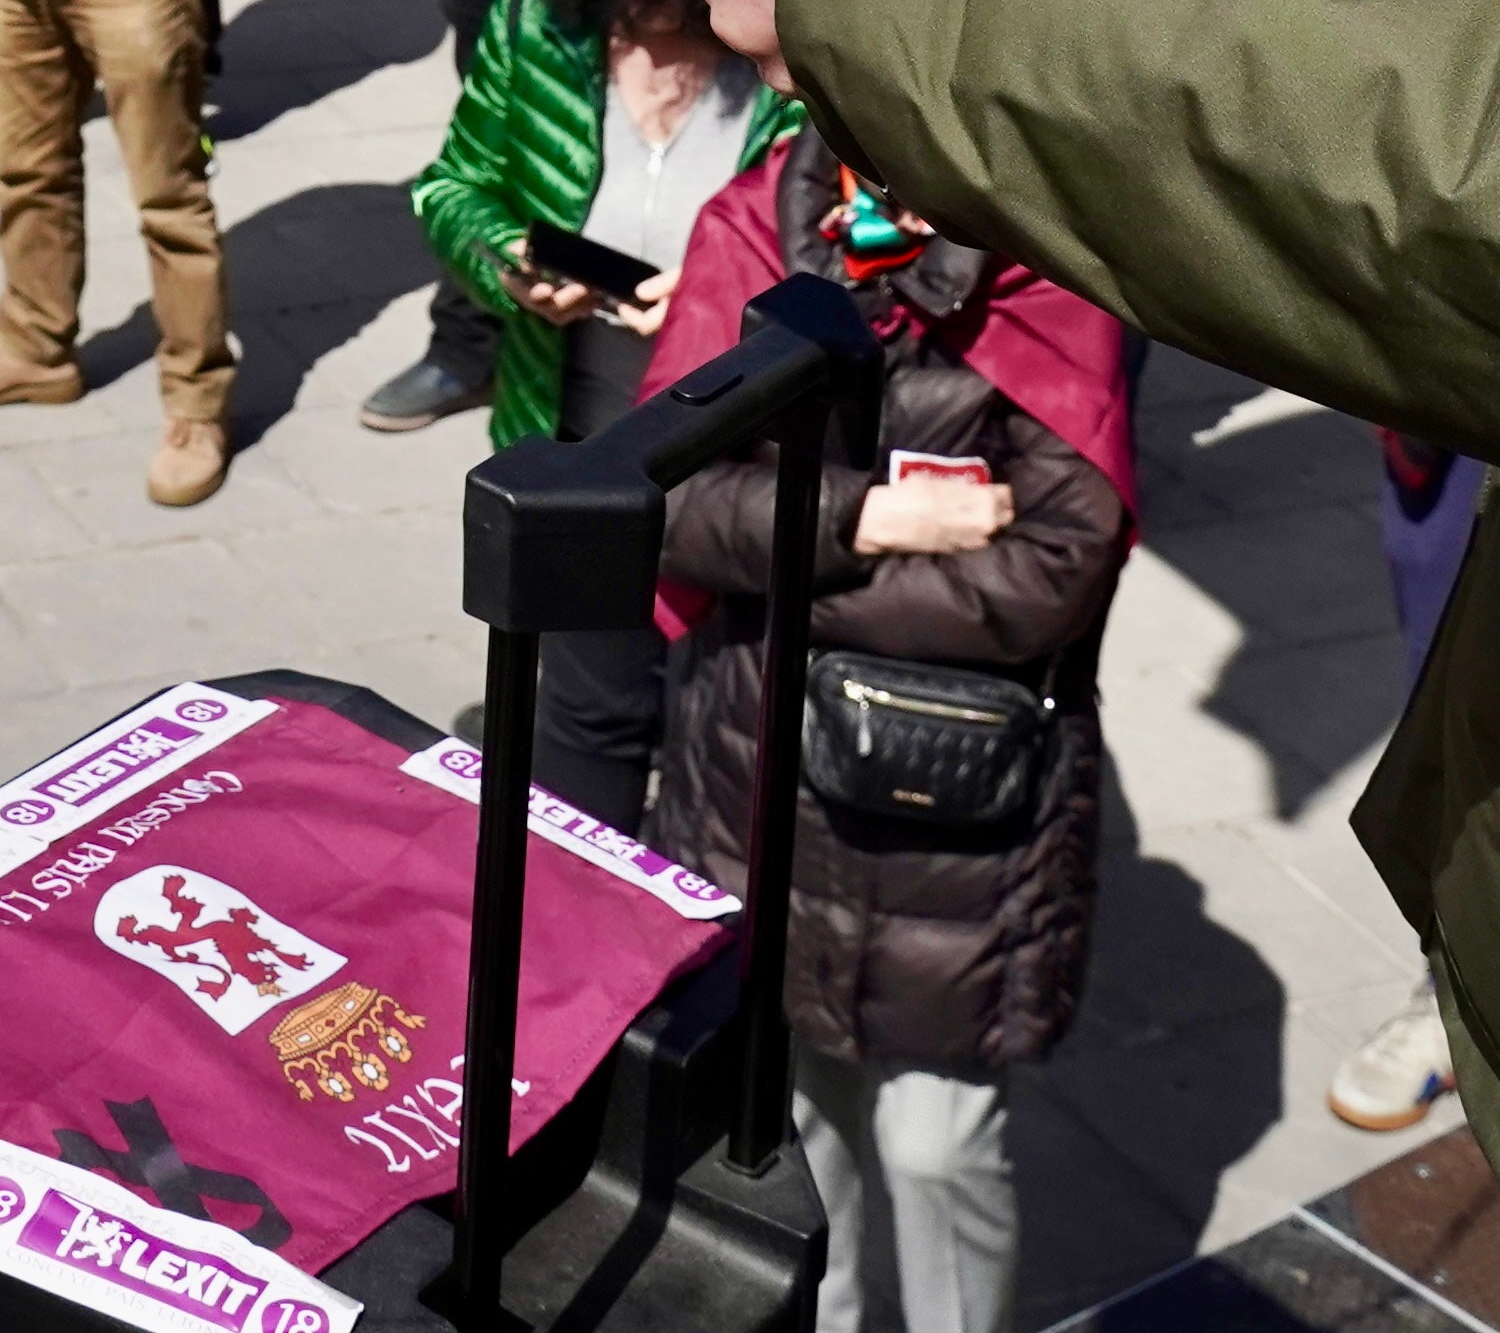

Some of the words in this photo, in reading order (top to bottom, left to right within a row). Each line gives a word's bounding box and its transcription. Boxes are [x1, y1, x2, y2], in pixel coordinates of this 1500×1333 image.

[181, 699, 223, 722] 18
[46, 749, 141, 805] LEXIT
[5, 801, 49, 824] 18
[527, 785, 598, 839] LEX
[118, 1238, 259, 1316] LEXIT
[274, 1302, 323, 1333] 18
